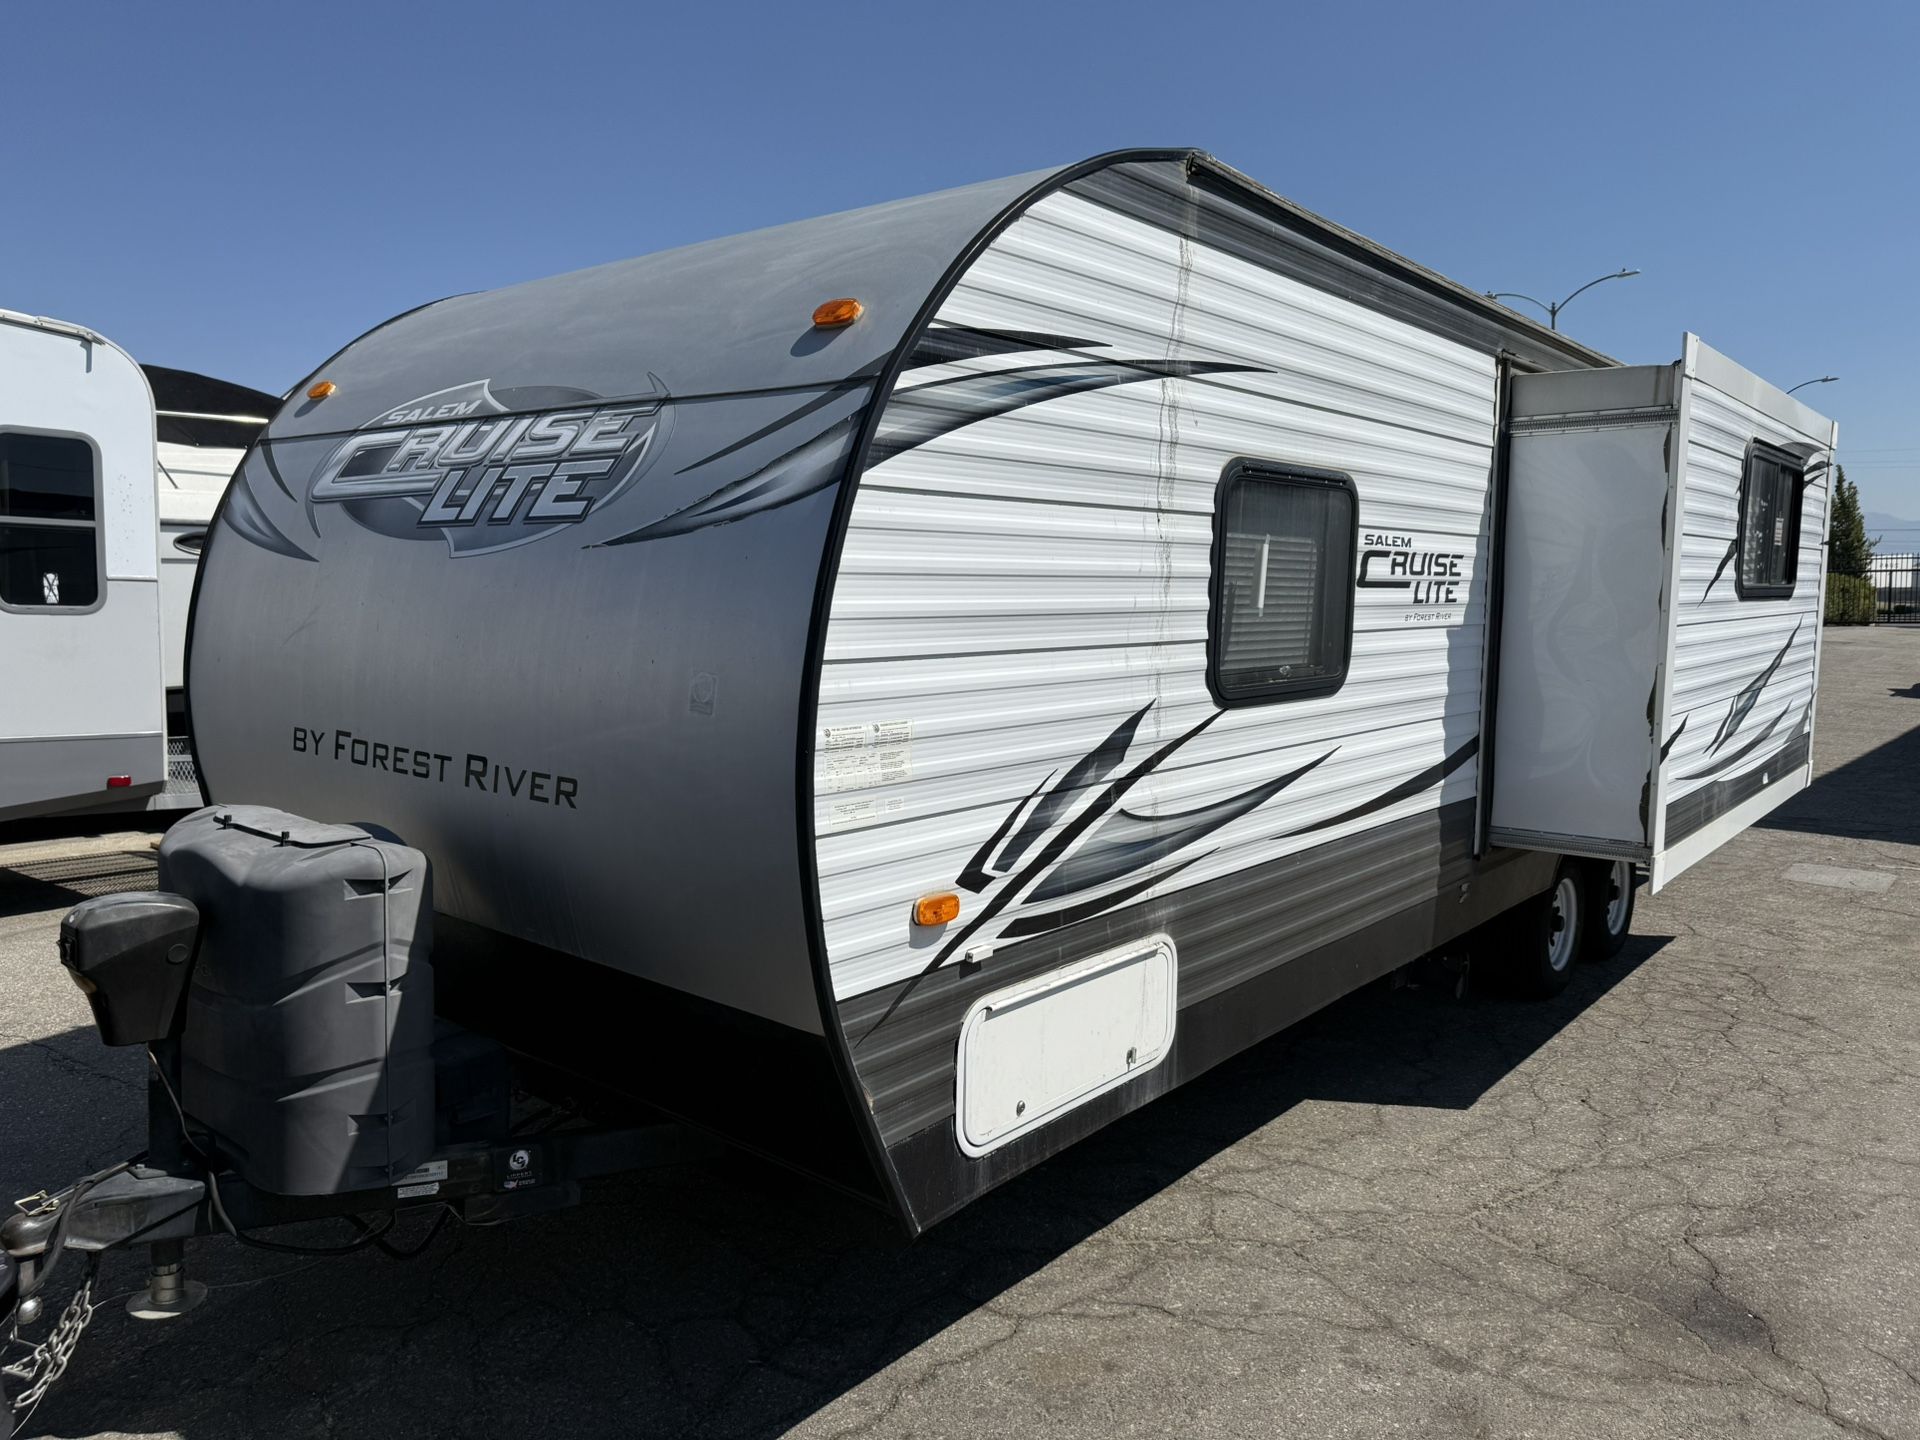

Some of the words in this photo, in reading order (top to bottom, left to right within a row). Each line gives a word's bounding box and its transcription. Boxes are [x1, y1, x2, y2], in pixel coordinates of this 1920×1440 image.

[383, 399, 482, 426] SALEM
[311, 402, 661, 501] CRUISE
[418, 457, 619, 527] LITE
[1364, 534, 1412, 548] SALEM
[1356, 549, 1464, 588] CRUISE
[1413, 581, 1460, 604] LITE
[293, 727, 325, 756] BY
[334, 729, 453, 782] FOREST
[464, 753, 579, 809] RIVER
